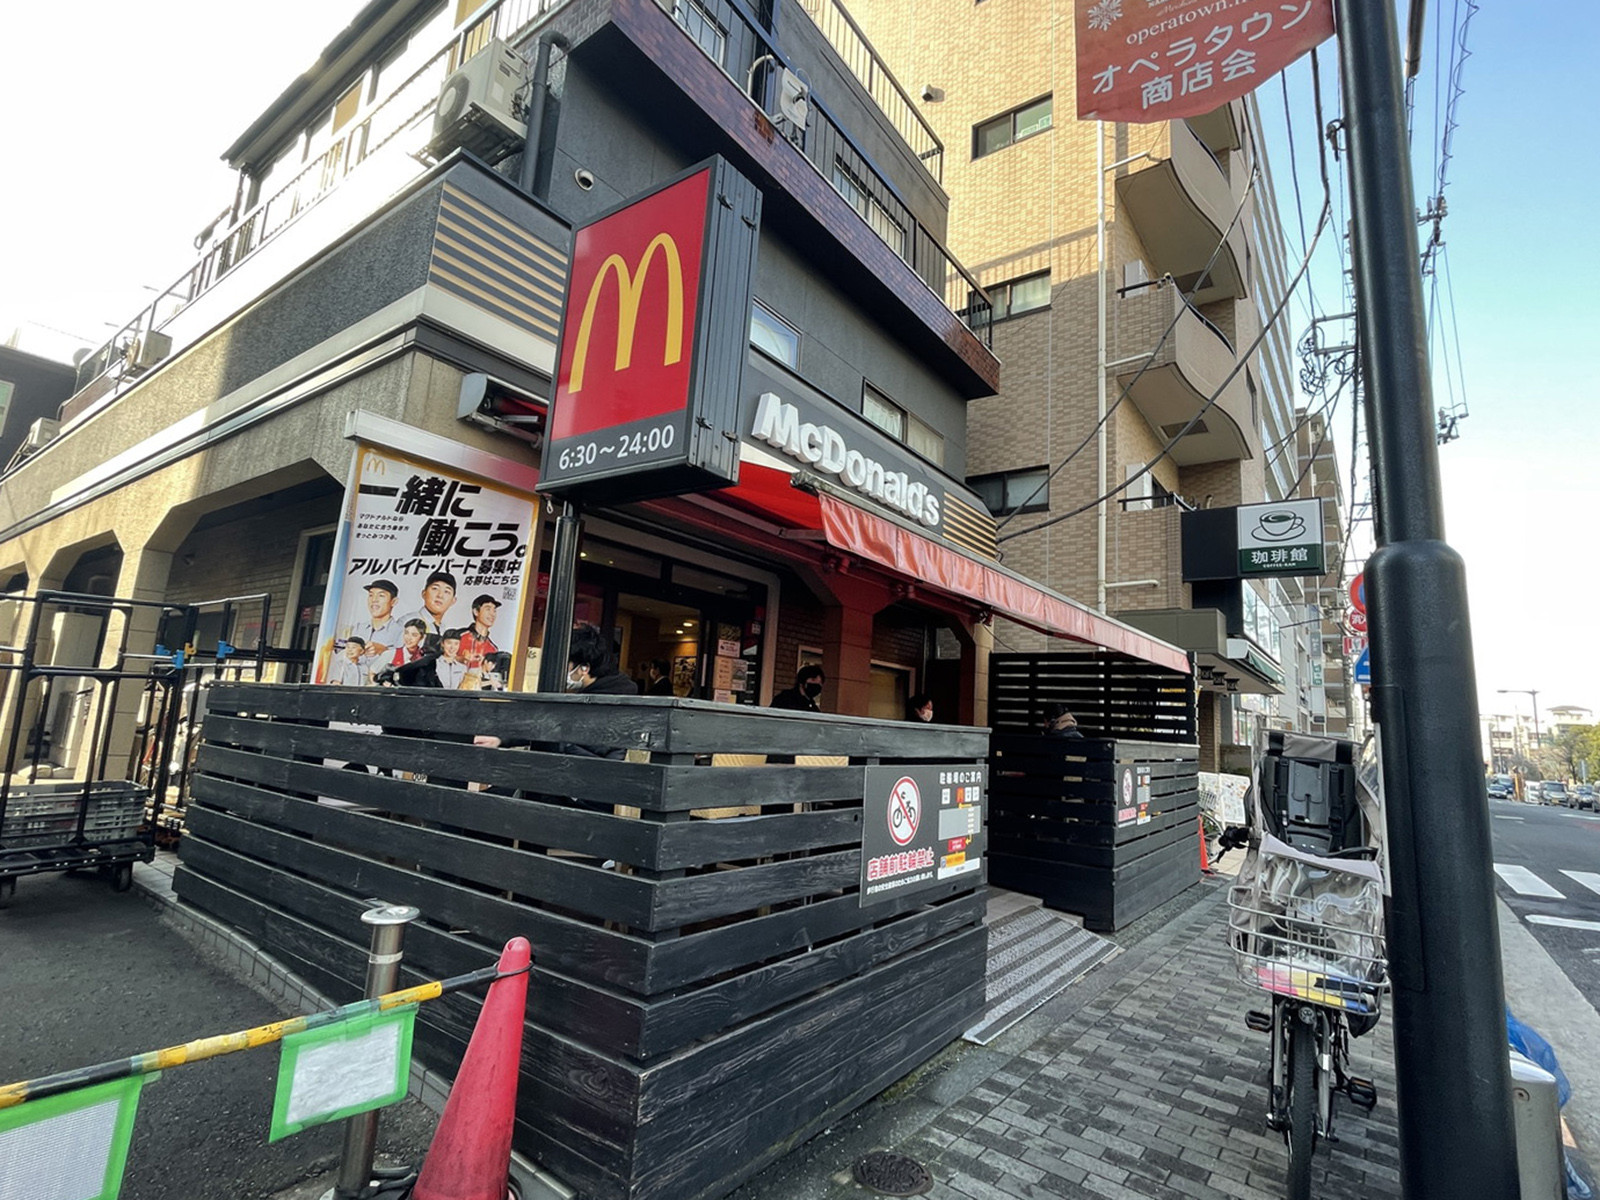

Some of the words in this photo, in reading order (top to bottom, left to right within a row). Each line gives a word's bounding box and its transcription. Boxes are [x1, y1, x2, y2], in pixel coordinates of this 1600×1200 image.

[1092, 0, 1312, 95] オペラタウン
[1140, 48, 1256, 110] 商店会
[751, 392, 940, 527] McDonald's
[358, 474, 482, 518] 一緒に
[412, 517, 528, 558] 働こう。
[1251, 547, 1308, 564] 珈琲館
